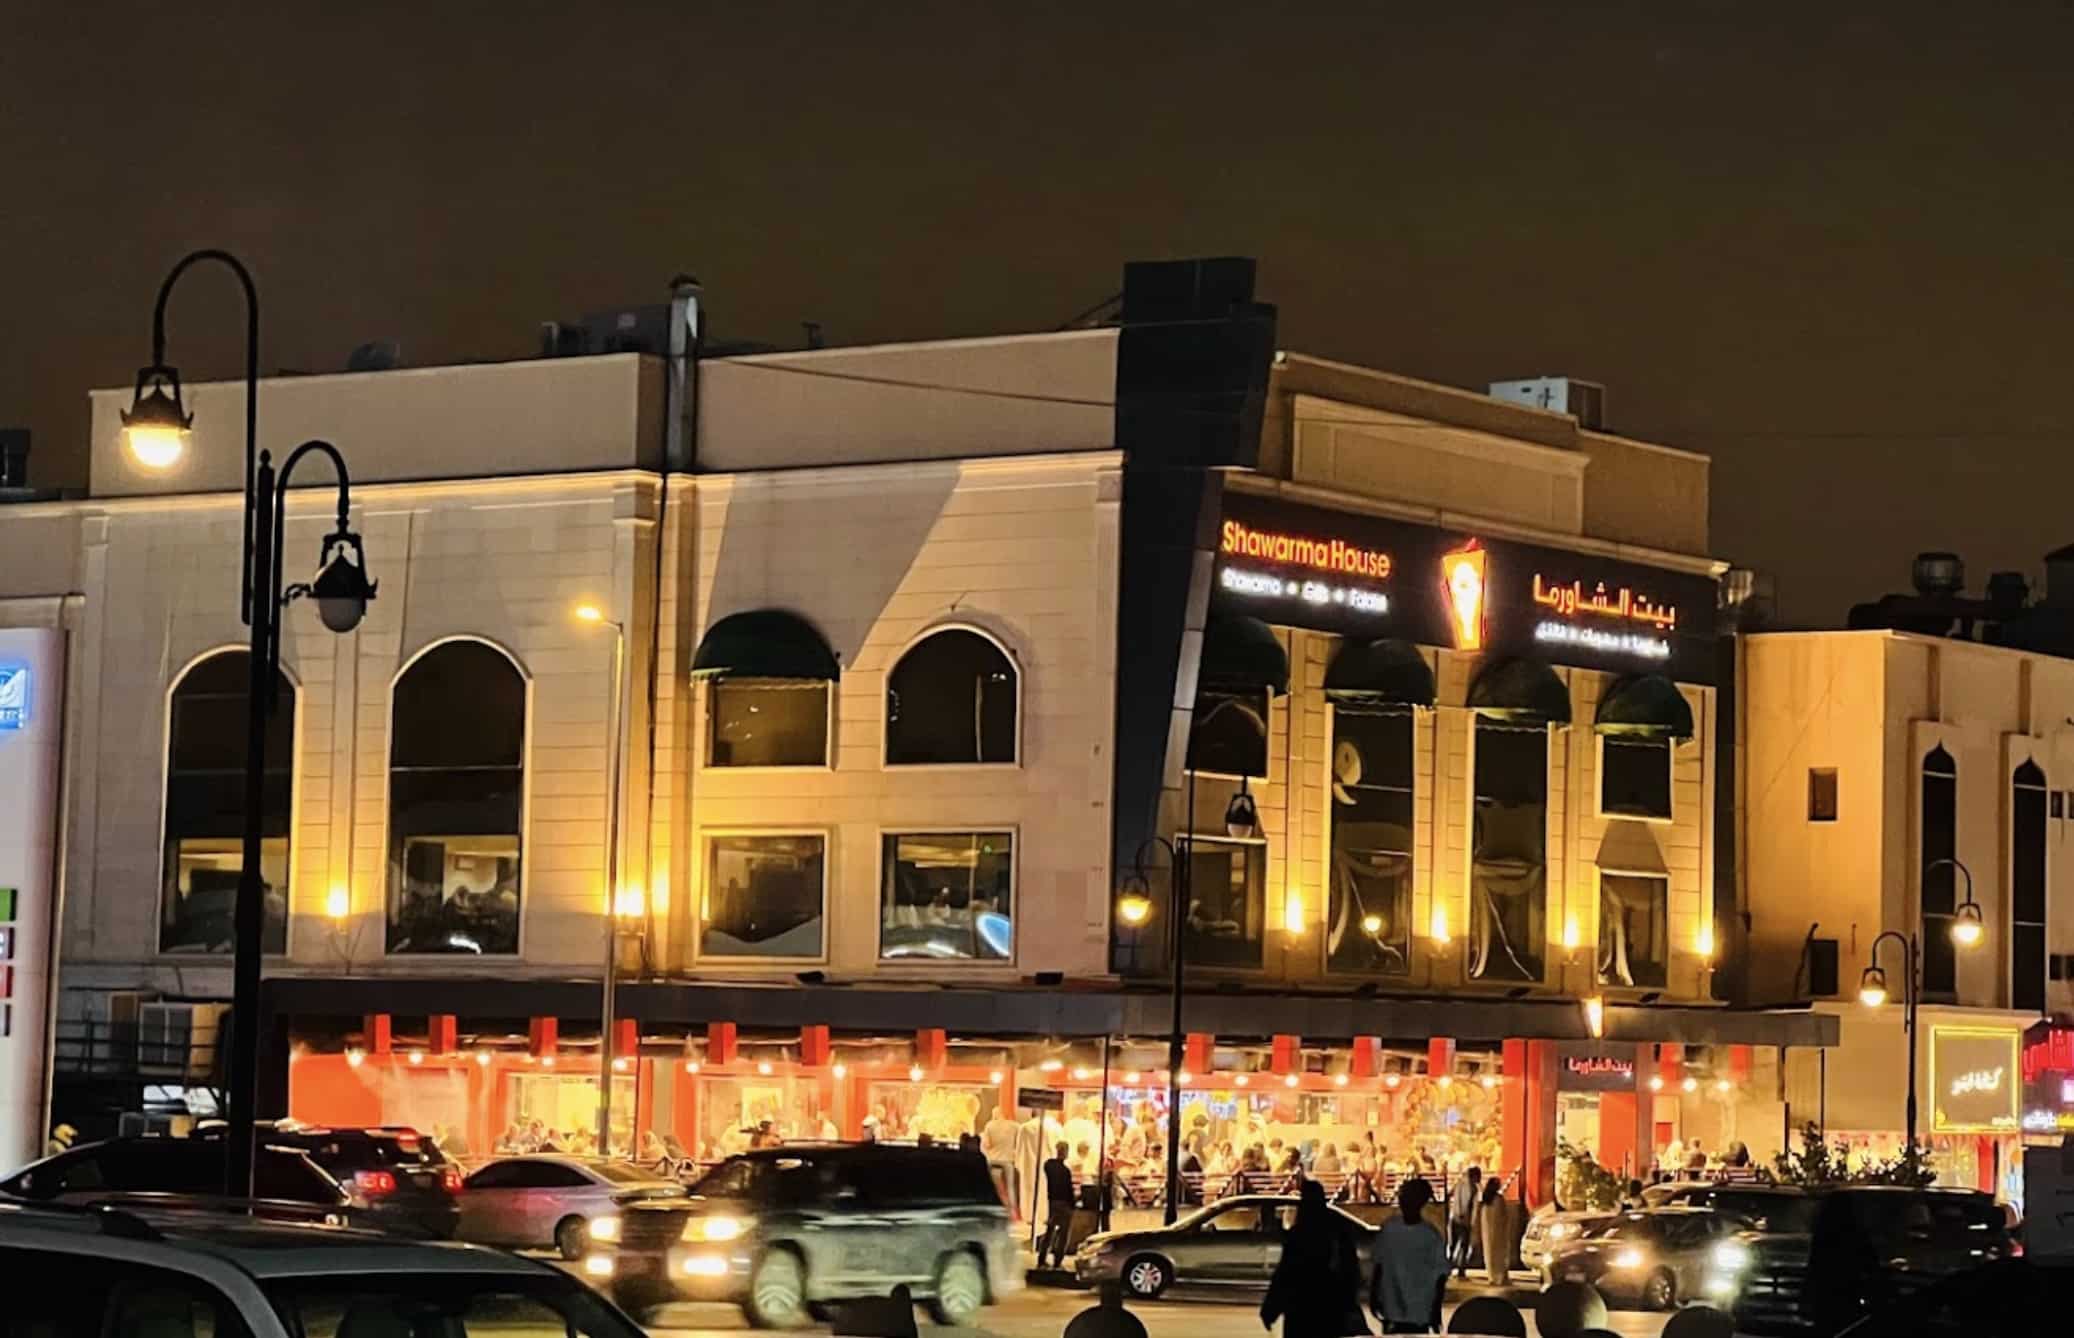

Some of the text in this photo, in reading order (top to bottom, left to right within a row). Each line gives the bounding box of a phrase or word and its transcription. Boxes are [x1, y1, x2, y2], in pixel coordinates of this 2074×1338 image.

[1222, 520, 1391, 578] Shawarma House
[1532, 572, 1676, 631] بيت الشاورما
